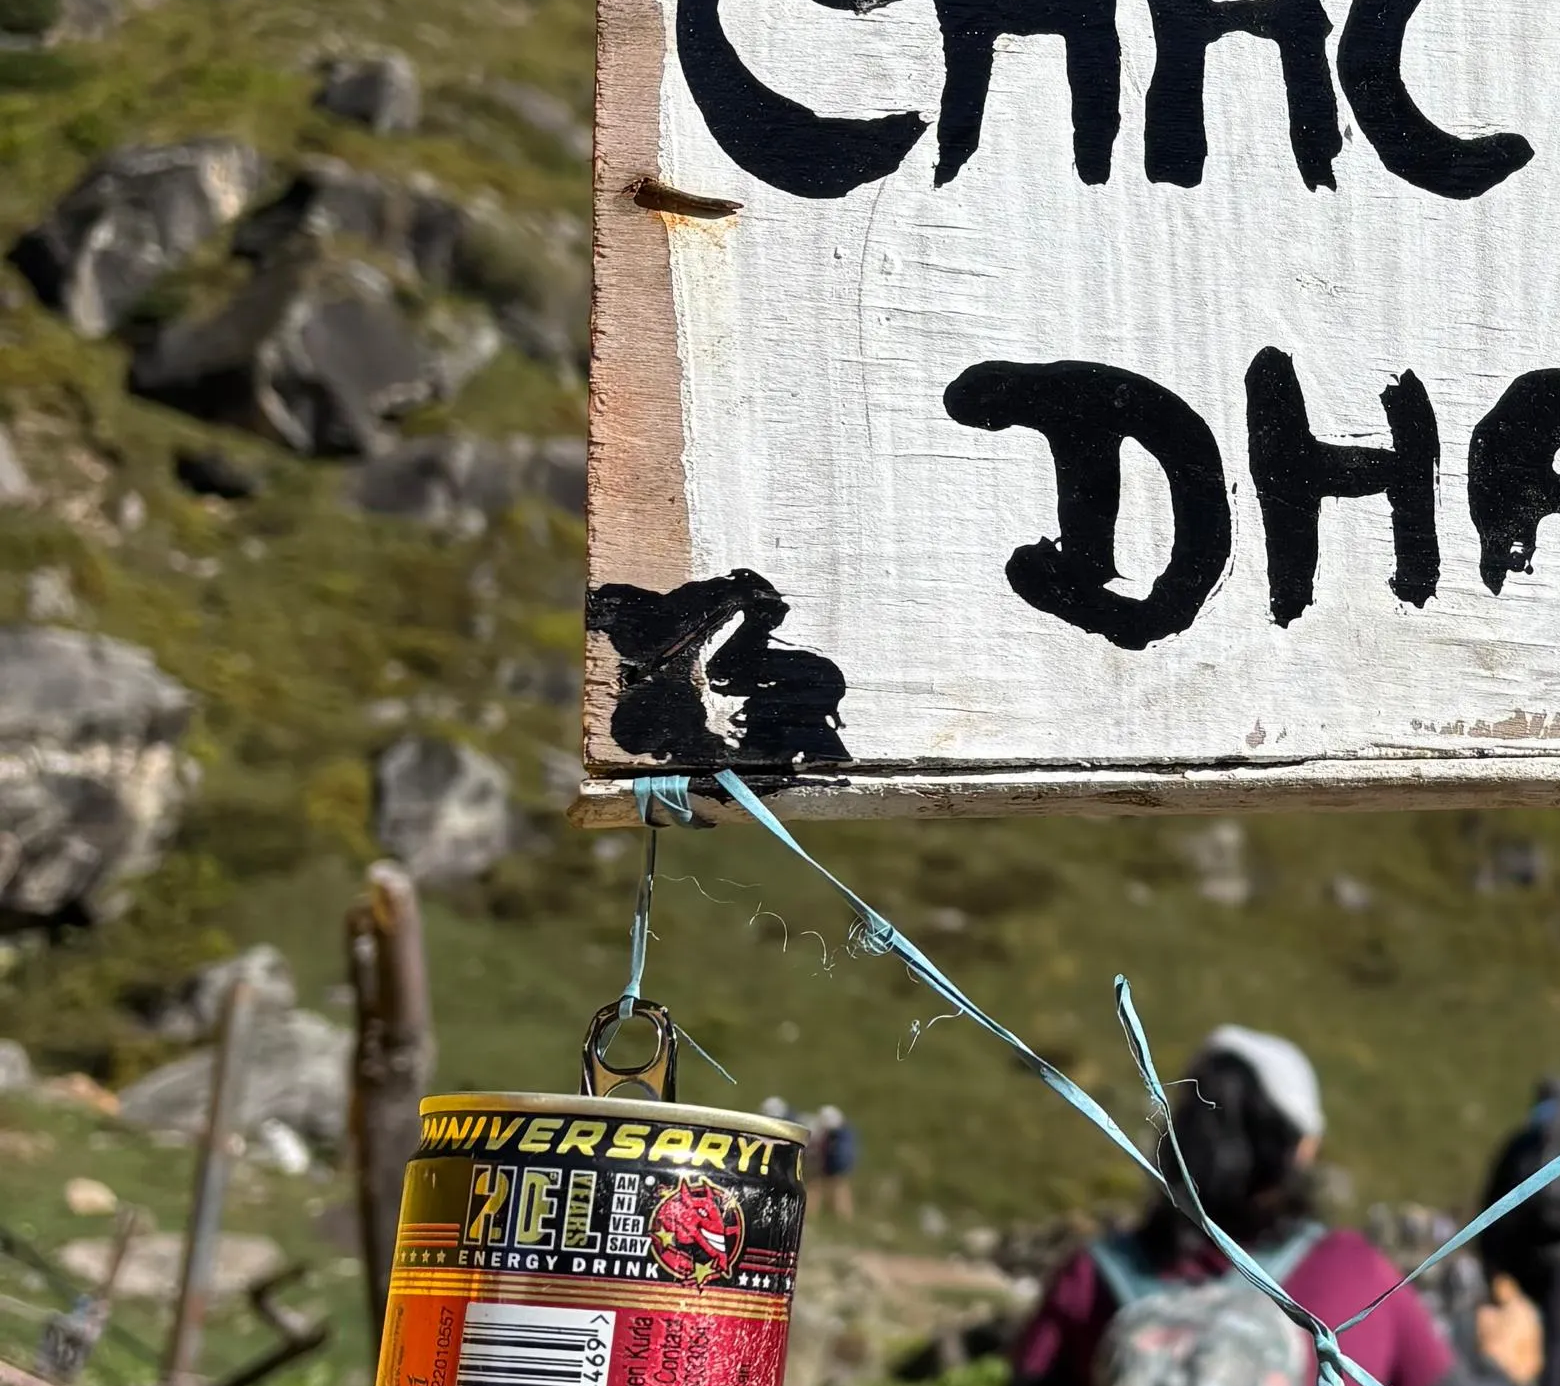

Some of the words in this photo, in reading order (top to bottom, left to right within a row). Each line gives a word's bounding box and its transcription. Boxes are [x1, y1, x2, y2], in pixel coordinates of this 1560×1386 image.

[421, 1116, 773, 1175] NNIVERSARY!
[616, 1174, 638, 1192] AN
[613, 1195, 634, 1213] NI
[611, 1216, 642, 1234] VER
[608, 1237, 648, 1255] SARY
[458, 1249, 559, 1273] ENERGY
[572, 1256, 660, 1279] DRINK
